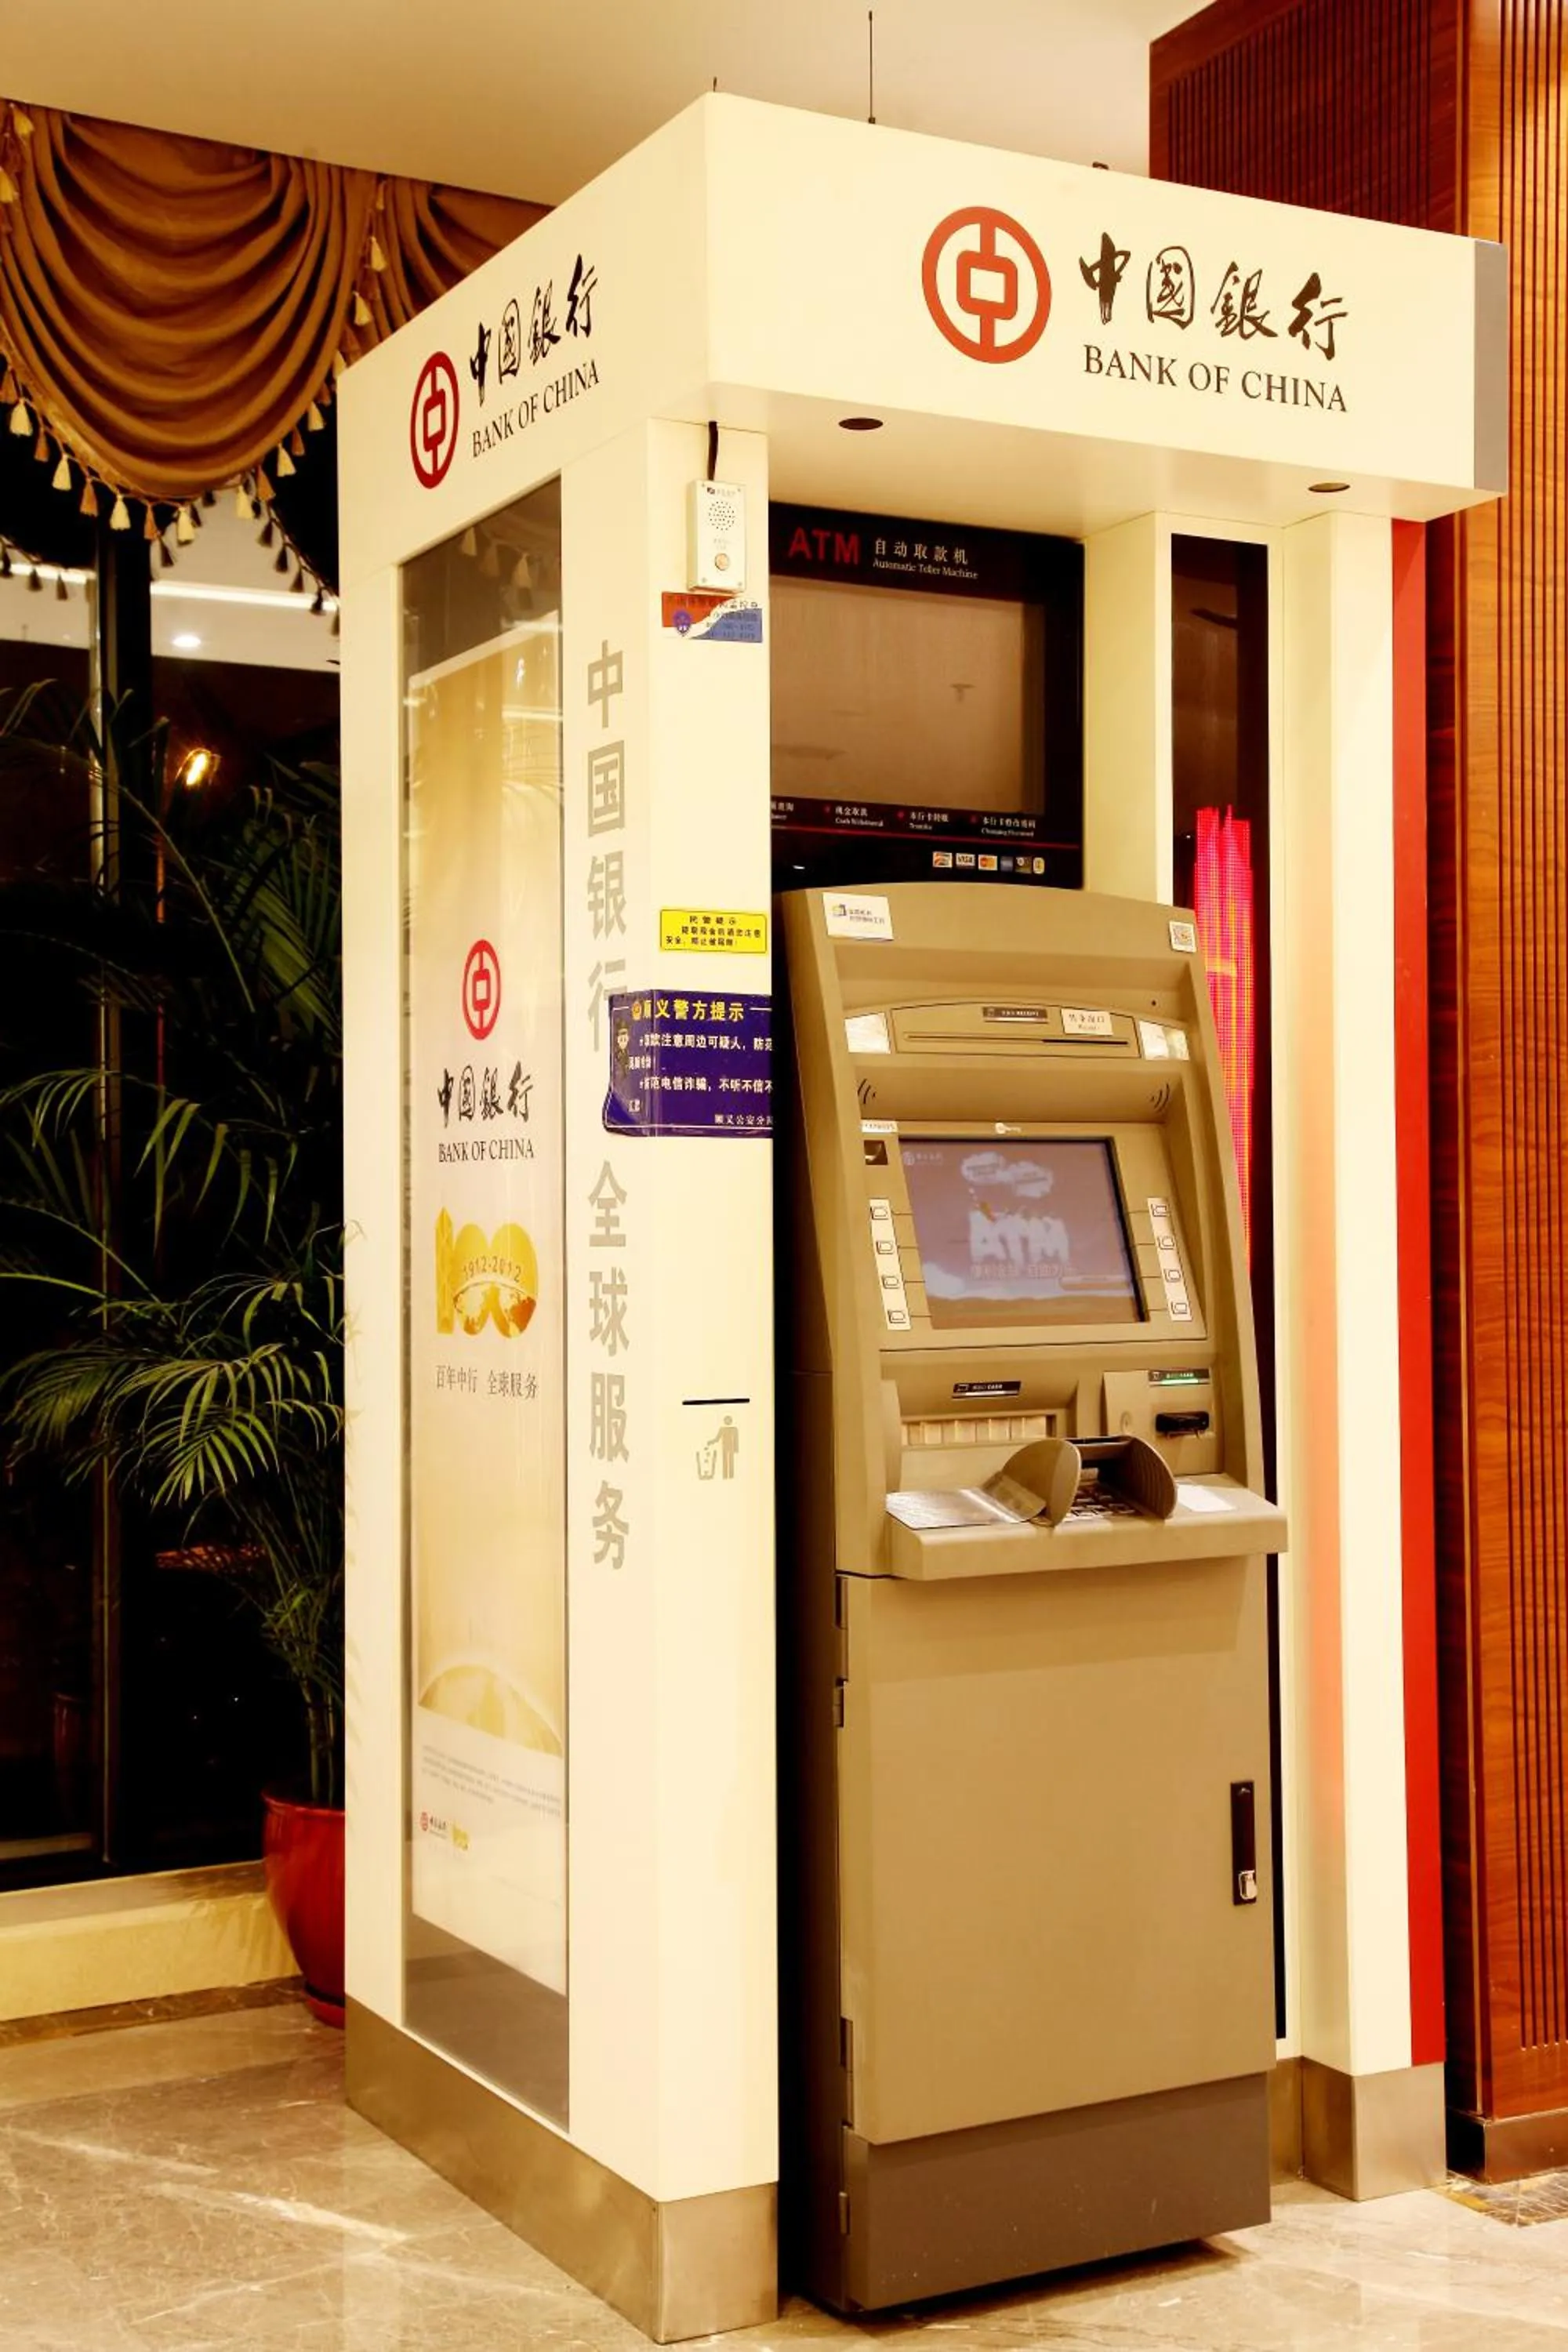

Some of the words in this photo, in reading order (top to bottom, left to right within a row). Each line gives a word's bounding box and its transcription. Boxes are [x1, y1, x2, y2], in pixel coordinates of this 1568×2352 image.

[1083, 343, 1178, 388] BANK
[1189, 361, 1231, 394] OF
[1241, 369, 1348, 413] CHINA
[472, 408, 515, 458] BANK
[517, 392, 539, 430] OF
[543, 358, 600, 414] CHINA
[788, 527, 859, 565] ATM
[875, 538, 968, 565] 自动取款机
[873, 558, 916, 572] Automatic
[918, 563, 941, 575] Teller
[942, 566, 979, 580] Machine
[586, 639, 628, 1053] 中国银行
[439, 1141, 469, 1163] BANK
[470, 1141, 487, 1162] OF
[489, 1138, 535, 1160] CHINA
[435, 1365, 477, 1394] 百年中行
[488, 1370, 537, 1399] 全球服务
[588, 1160, 630, 1570] 全球服务
